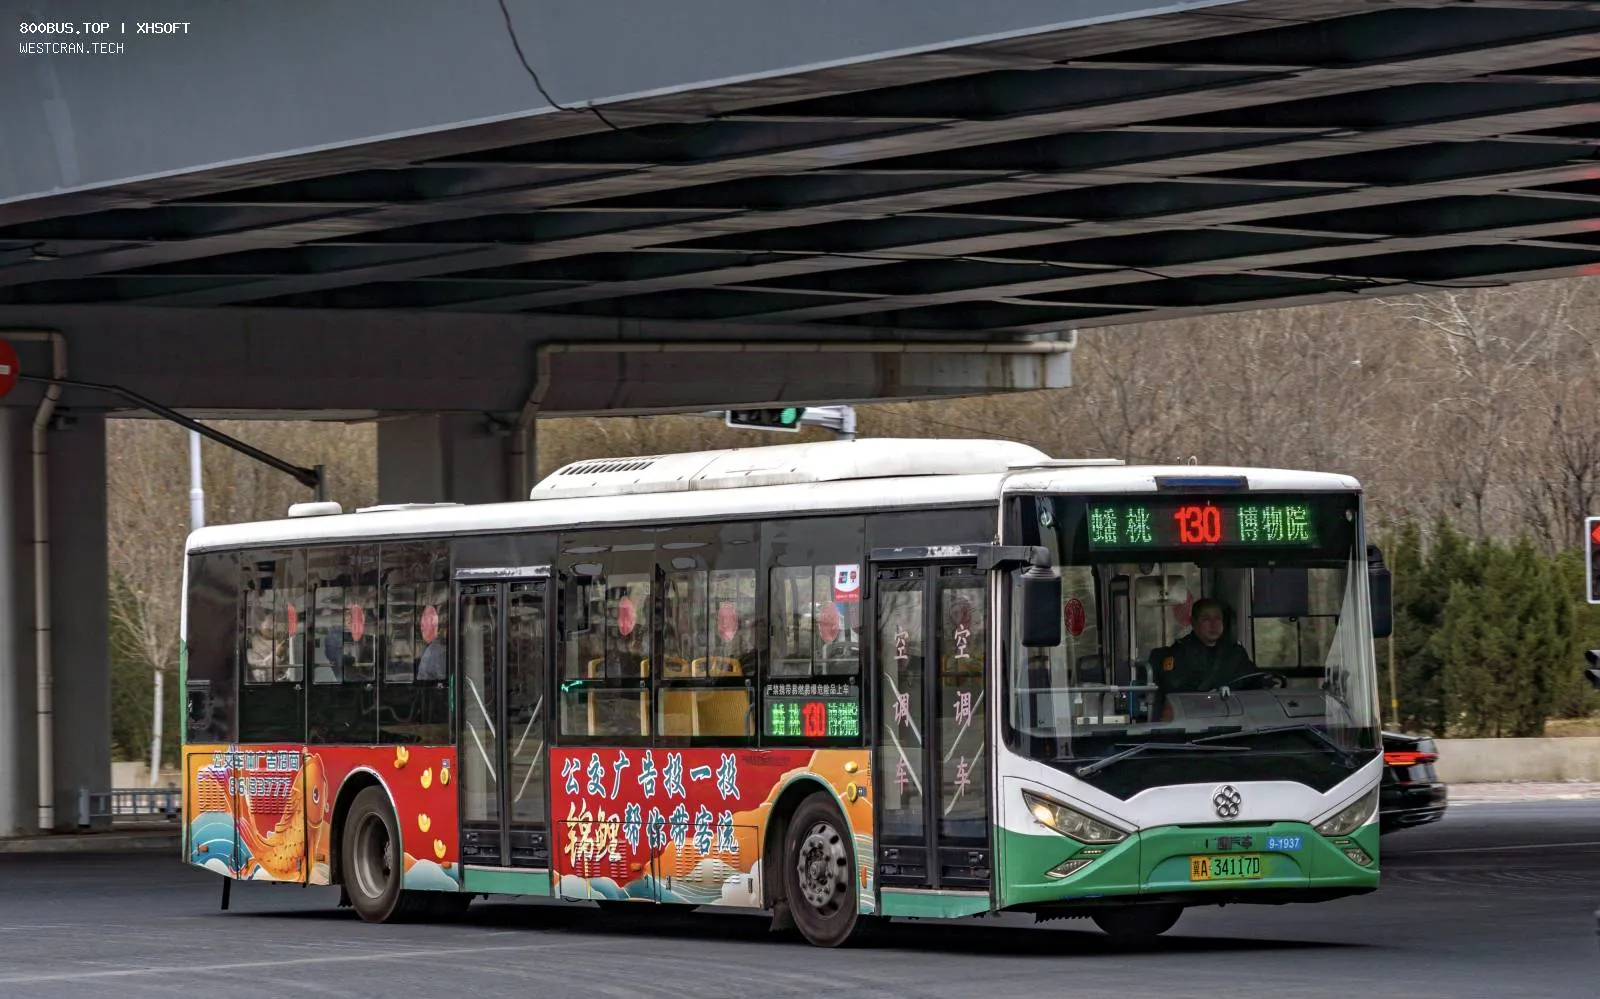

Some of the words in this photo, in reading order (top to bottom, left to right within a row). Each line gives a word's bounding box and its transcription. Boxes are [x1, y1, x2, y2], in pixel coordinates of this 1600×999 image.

[1174, 506, 1221, 543] 130
[1237, 505, 1309, 542] 博物院
[892, 625, 910, 795] 空调车
[953, 624, 972, 796] 空调车
[561, 750, 741, 800] 公交广告投一投
[1268, 837, 1300, 849] 9-1937
